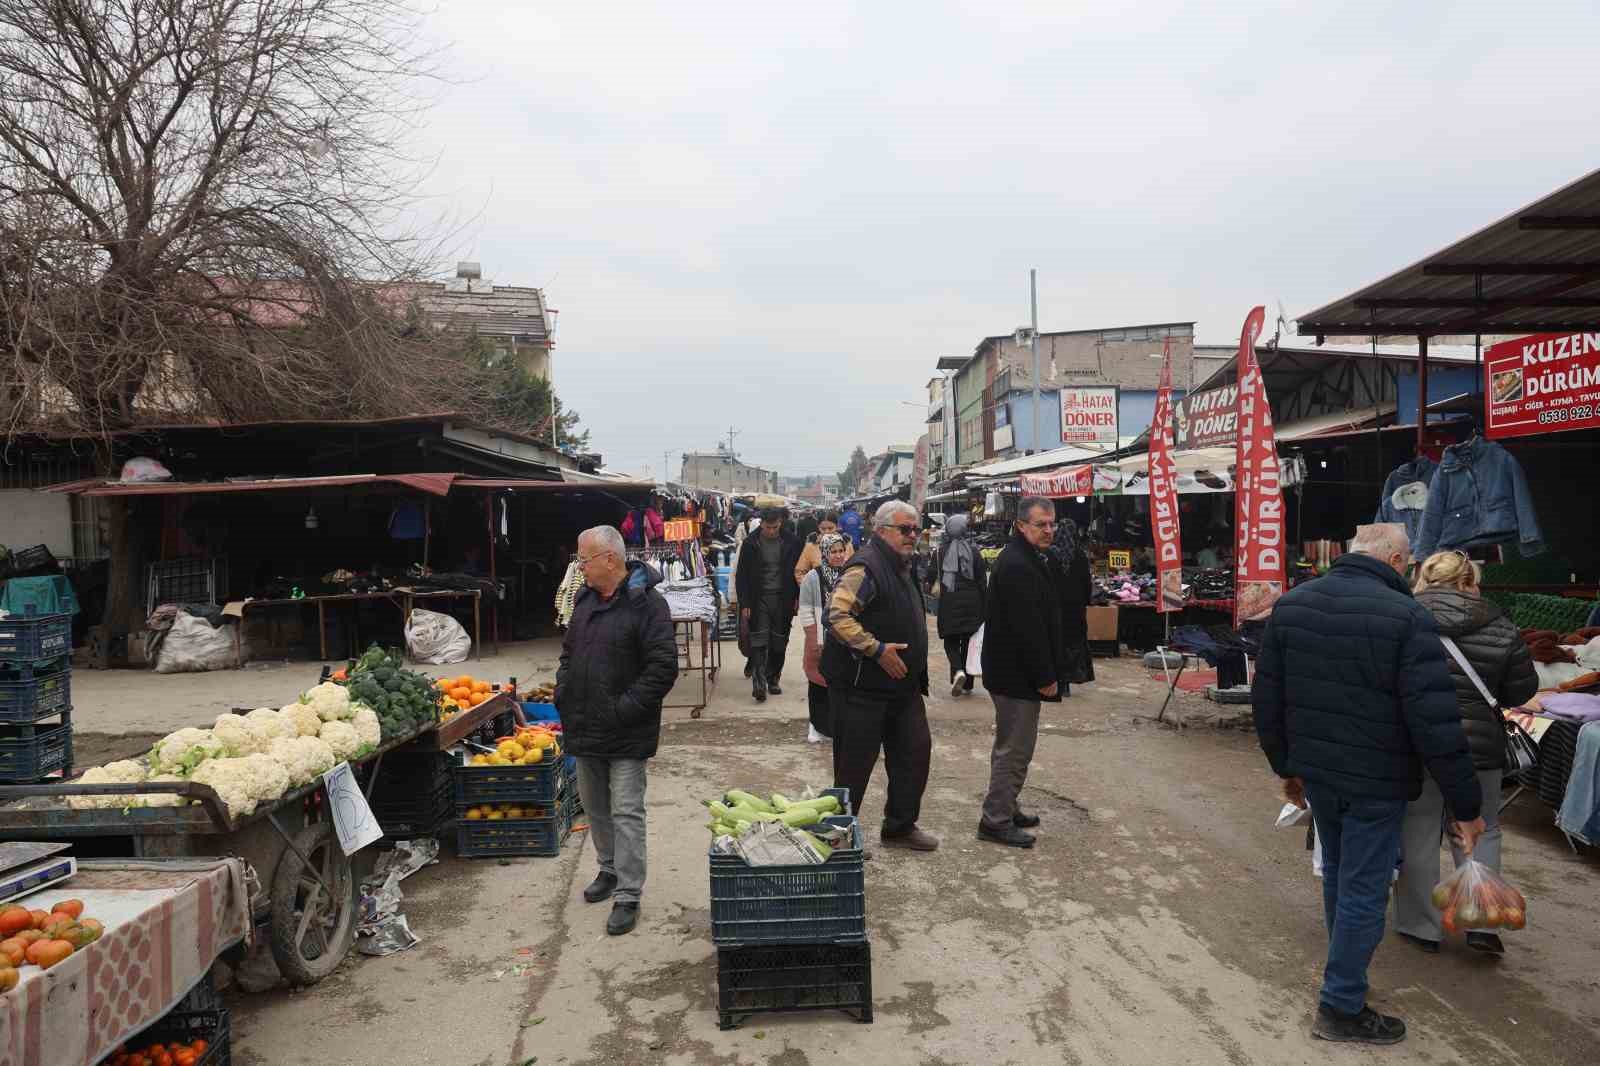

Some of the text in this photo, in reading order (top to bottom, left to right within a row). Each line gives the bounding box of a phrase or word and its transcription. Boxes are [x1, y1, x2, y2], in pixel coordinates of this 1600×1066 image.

[1523, 333, 1600, 366] KUZEN
[1526, 363, 1600, 396] DÜRÜM
[1082, 393, 1112, 409] HATAY
[1189, 385, 1238, 414] HATAY
[1066, 410, 1114, 426] DÖNER
[1539, 409, 1568, 424] 0538
[1570, 404, 1592, 420] 922
